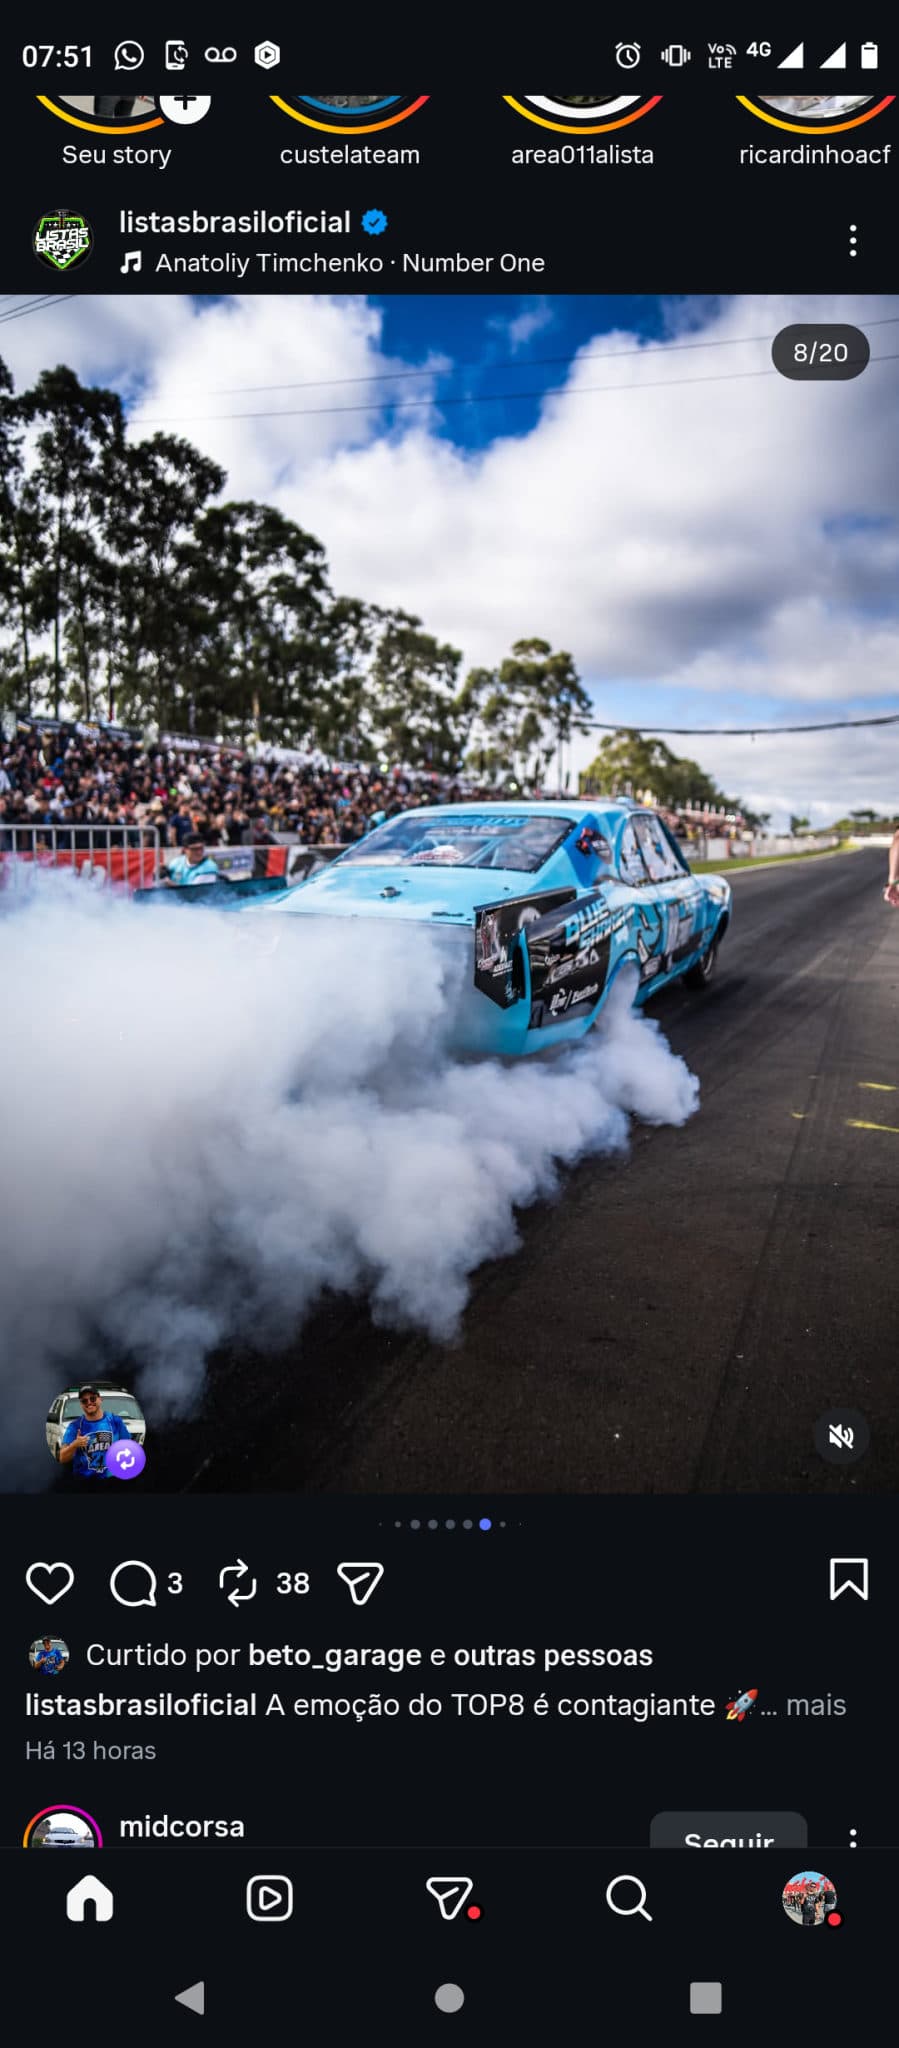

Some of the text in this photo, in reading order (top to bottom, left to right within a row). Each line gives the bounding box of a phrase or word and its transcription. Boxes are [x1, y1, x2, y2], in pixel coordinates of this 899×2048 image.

[22, 45, 92, 69] 07:51
[745, 41, 772, 57] 4G
[708, 57, 732, 69] LTE
[62, 145, 172, 170] Seu story
[279, 144, 420, 165] custelateam
[511, 144, 654, 165] area011alista
[740, 144, 891, 165] ricardinhoacf
[119, 209, 351, 234] listasbrasiloficial
[35, 227, 89, 242] LISTAS
[36, 238, 89, 252] BRASIL
[155, 252, 546, 278] Anatoliy Timchenko Number One
[167, 1571, 184, 1595] 3
[276, 1571, 311, 1595] 38
[86, 1642, 654, 1673] Curtido por beto_garage e outras pessoas
[25, 1692, 257, 1717] listasbrasiloficial
[264, 1694, 286, 1716] A
[293, 1693, 400, 1723] emoção
[408, 1692, 443, 1716] do
[450, 1693, 525, 1717] TOP8
[533, 1692, 550, 1716] é
[557, 1692, 716, 1723] contagiante
[786, 1692, 847, 1716] mais
[25, 1739, 157, 1761] Há 13 horas
[119, 1813, 245, 1838] midcorsa
